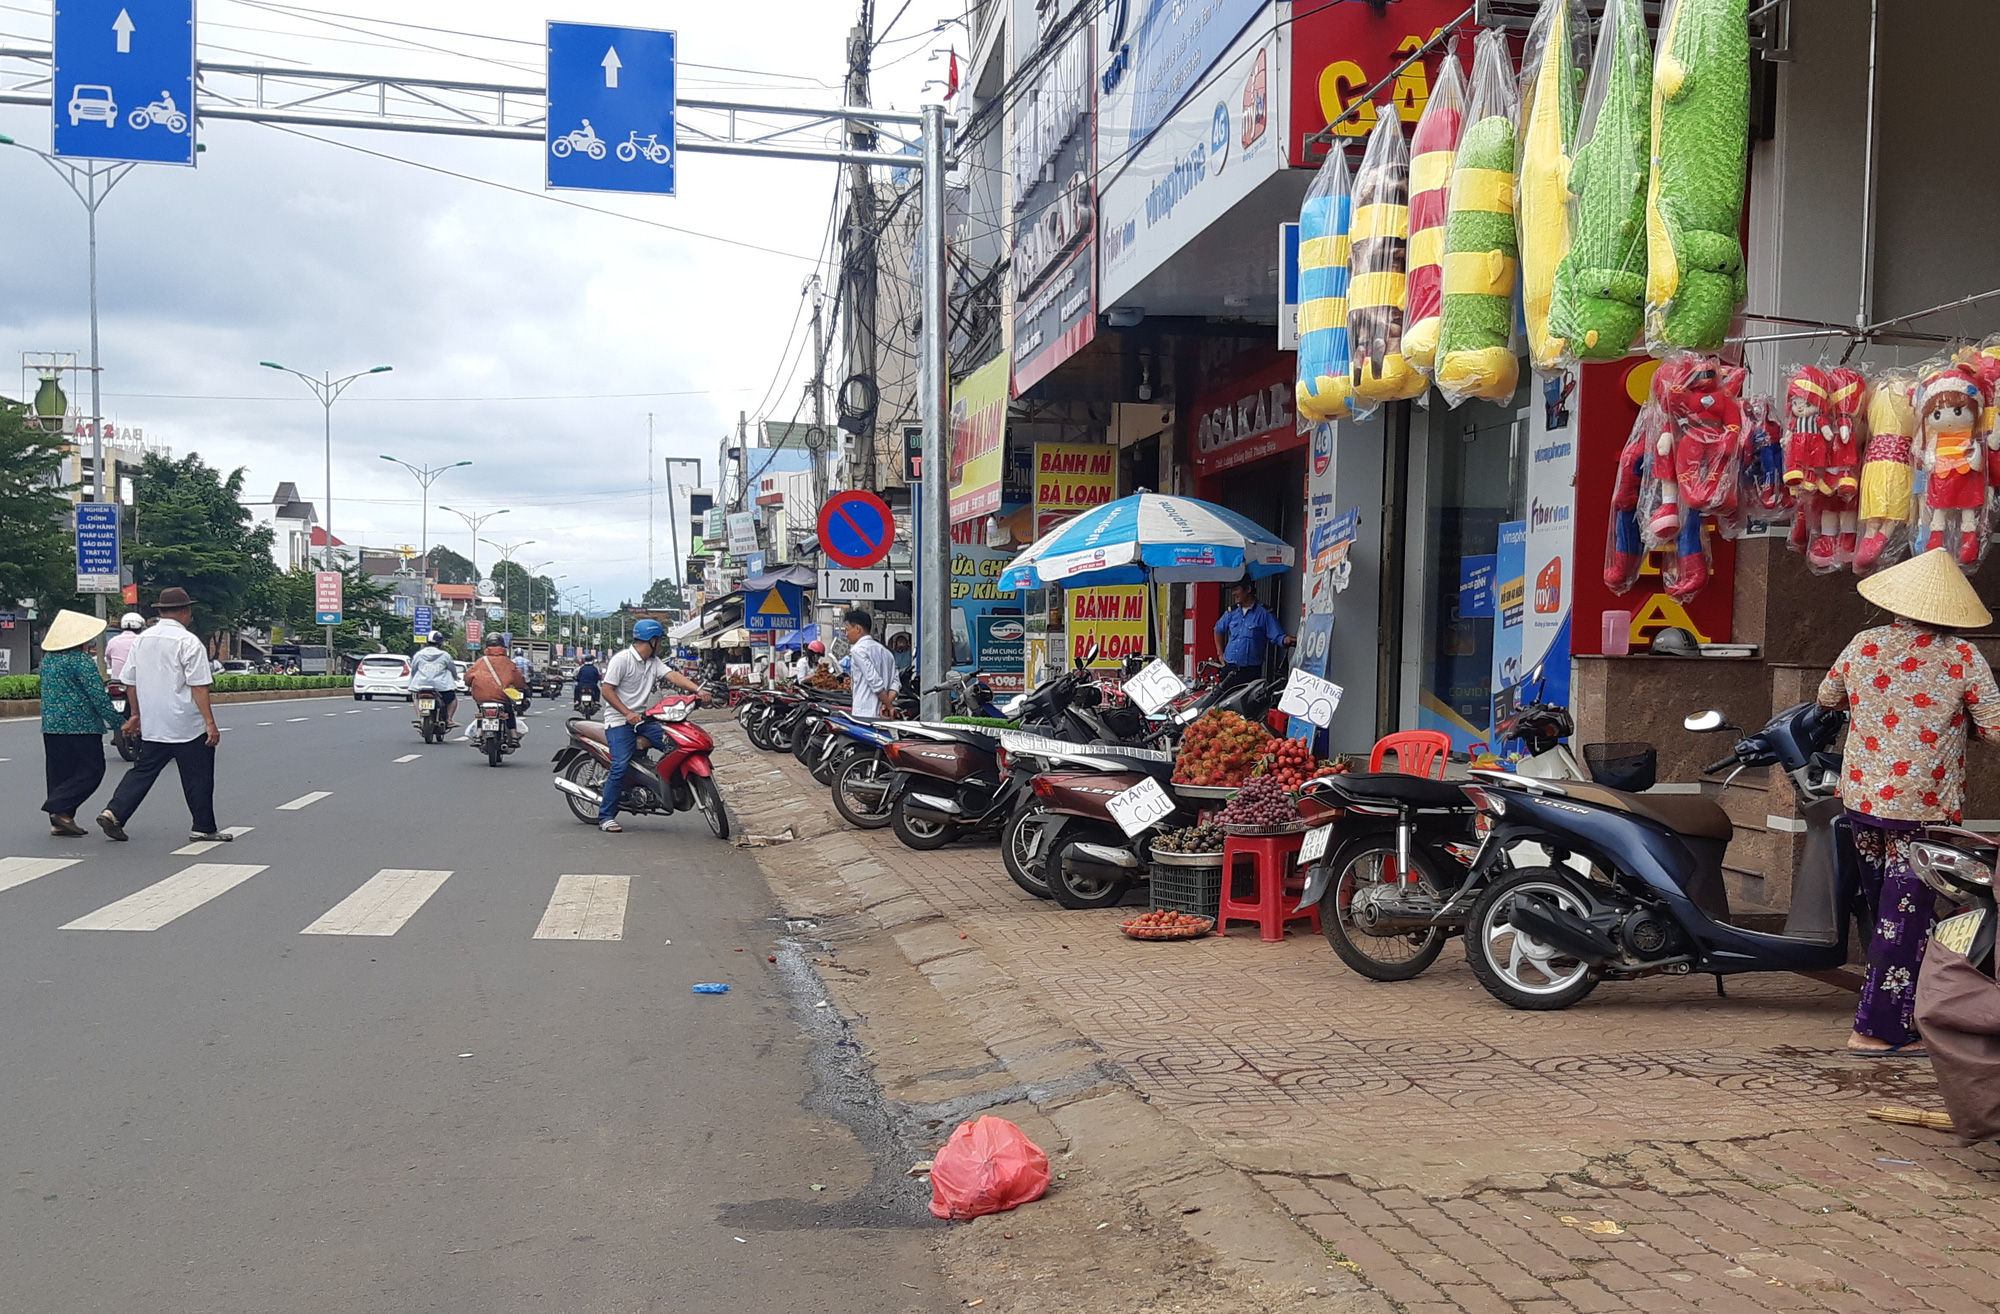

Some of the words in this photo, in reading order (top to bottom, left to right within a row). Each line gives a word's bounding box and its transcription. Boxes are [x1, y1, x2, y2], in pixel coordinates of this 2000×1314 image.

[1213, 115, 1225, 146] 4G
[1145, 142, 1206, 229] vinaphone
[1040, 449, 1087, 474] BÁNH
[1535, 441, 1571, 464] vinaphone
[1065, 485, 1111, 504] LOAN
[1158, 501, 1196, 537] vinaphone
[839, 578, 860, 593] 200
[863, 581, 874, 593] m
[951, 580, 970, 599] ÉP
[1074, 588, 1120, 620] BÁNH
[770, 616, 797, 628] MARKET
[1099, 635, 1144, 660] LOAN
[1280, 687, 1333, 727] 30
[920, 751, 957, 761] LEAD
[1533, 797, 1589, 815] VISION
